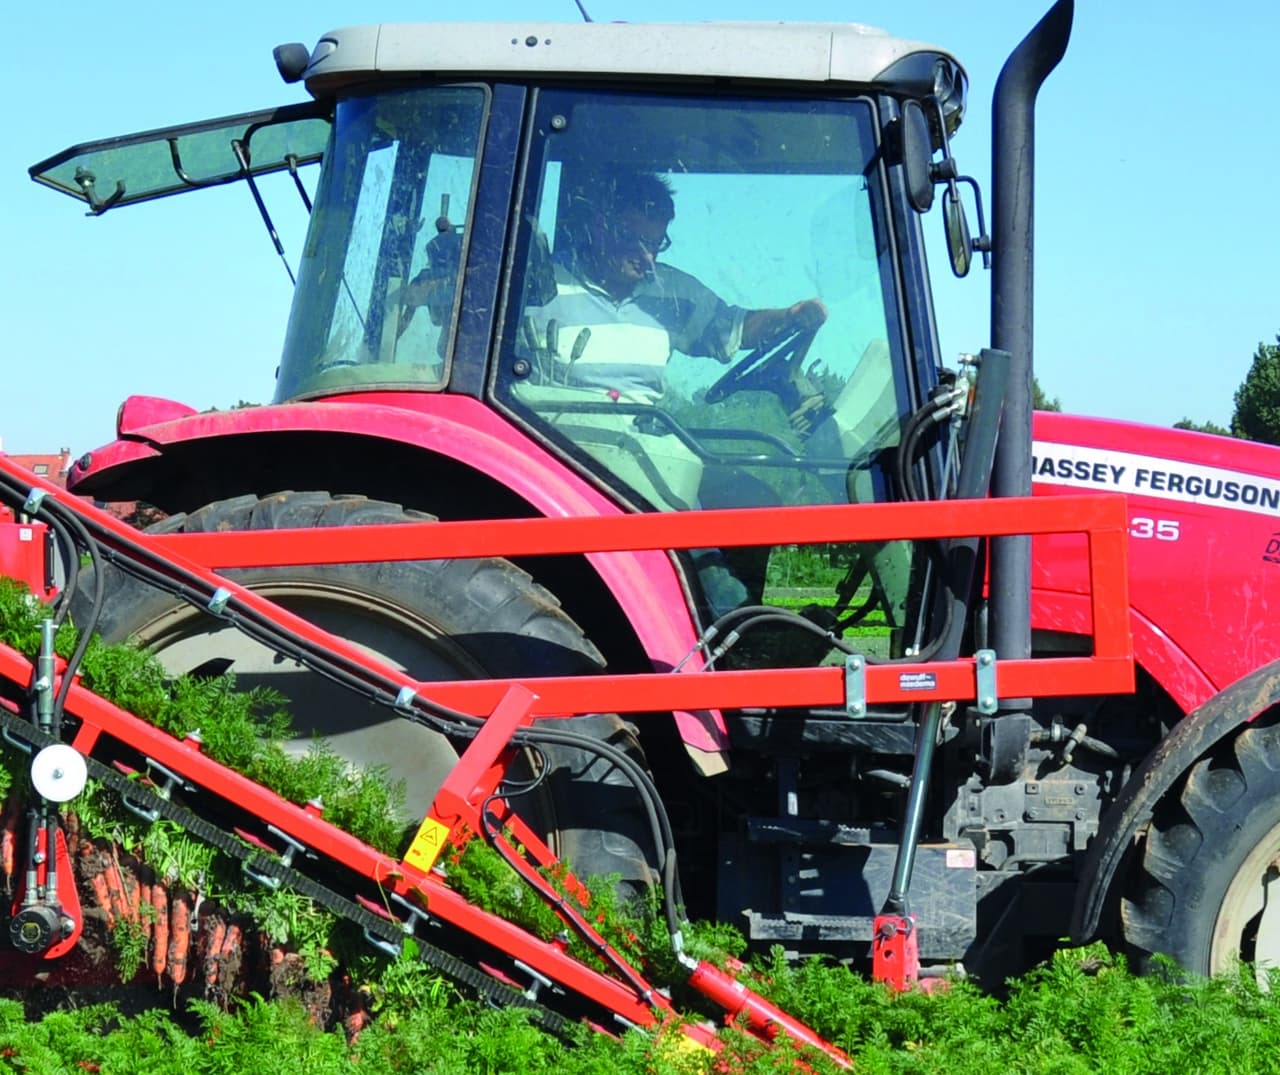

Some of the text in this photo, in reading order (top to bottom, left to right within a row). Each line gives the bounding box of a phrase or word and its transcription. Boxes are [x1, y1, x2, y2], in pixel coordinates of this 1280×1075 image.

[1032, 456, 1280, 509] ASSEY FERGUSON
[1127, 517, 1180, 542] 35
